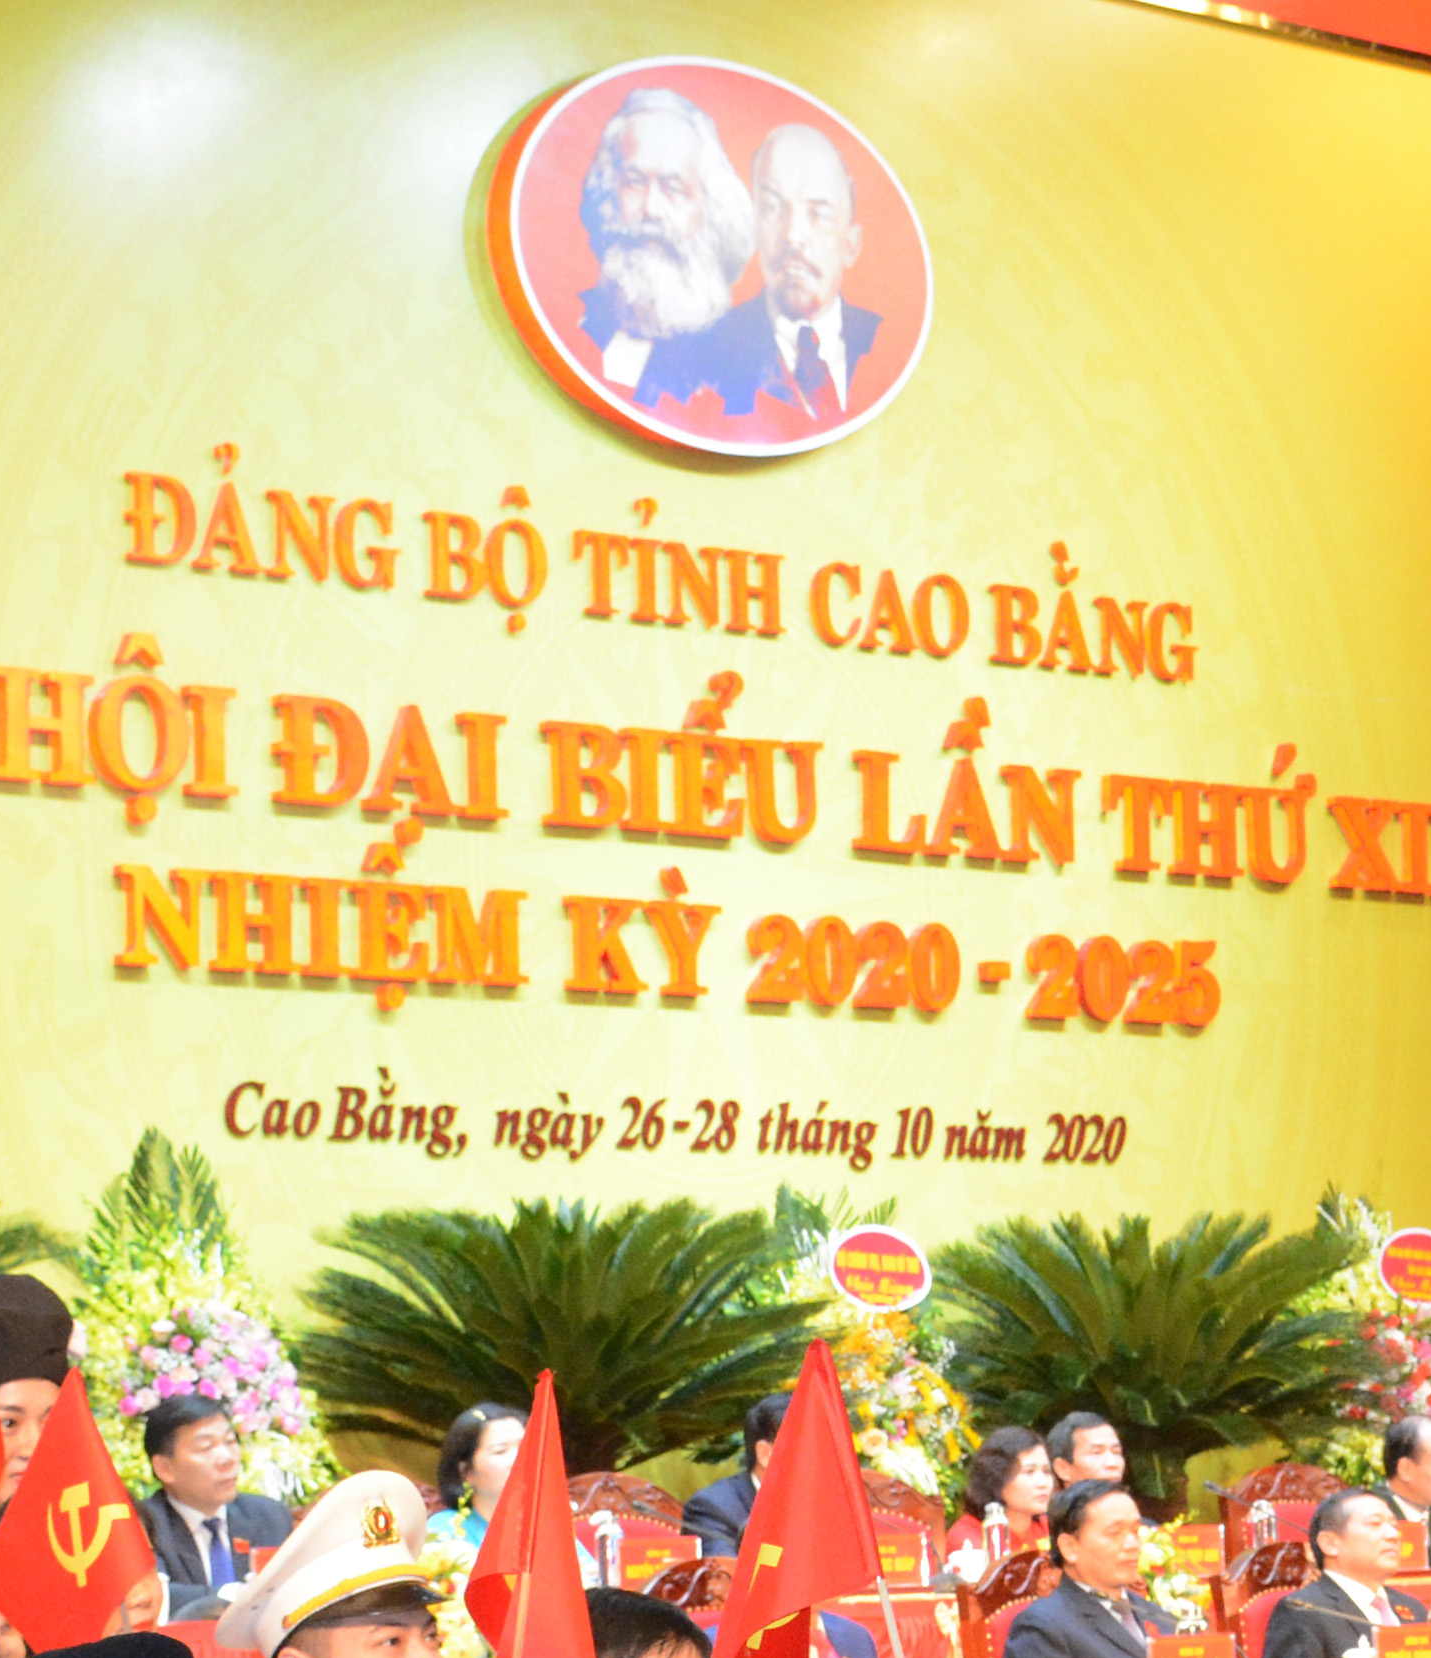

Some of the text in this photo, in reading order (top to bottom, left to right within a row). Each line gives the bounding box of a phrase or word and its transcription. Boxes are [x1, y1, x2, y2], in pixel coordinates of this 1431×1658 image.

[124, 443, 1195, 682] ĐẢNG BỘ TỈNH CAO BẰNG
[271, 695, 510, 850] ĐẠI
[539, 671, 822, 846] BIỂU
[852, 697, 1081, 866] LẦN
[1101, 743, 1317, 889] THỨ
[113, 840, 529, 1012] NHIỆM
[562, 867, 721, 998] KỲ
[746, 915, 960, 1014] 2020
[1025, 935, 1220, 1033] 2025
[224, 1065, 1128, 1172] Cao Bằng, ngày 26-28 tháng 10 năm 2020
